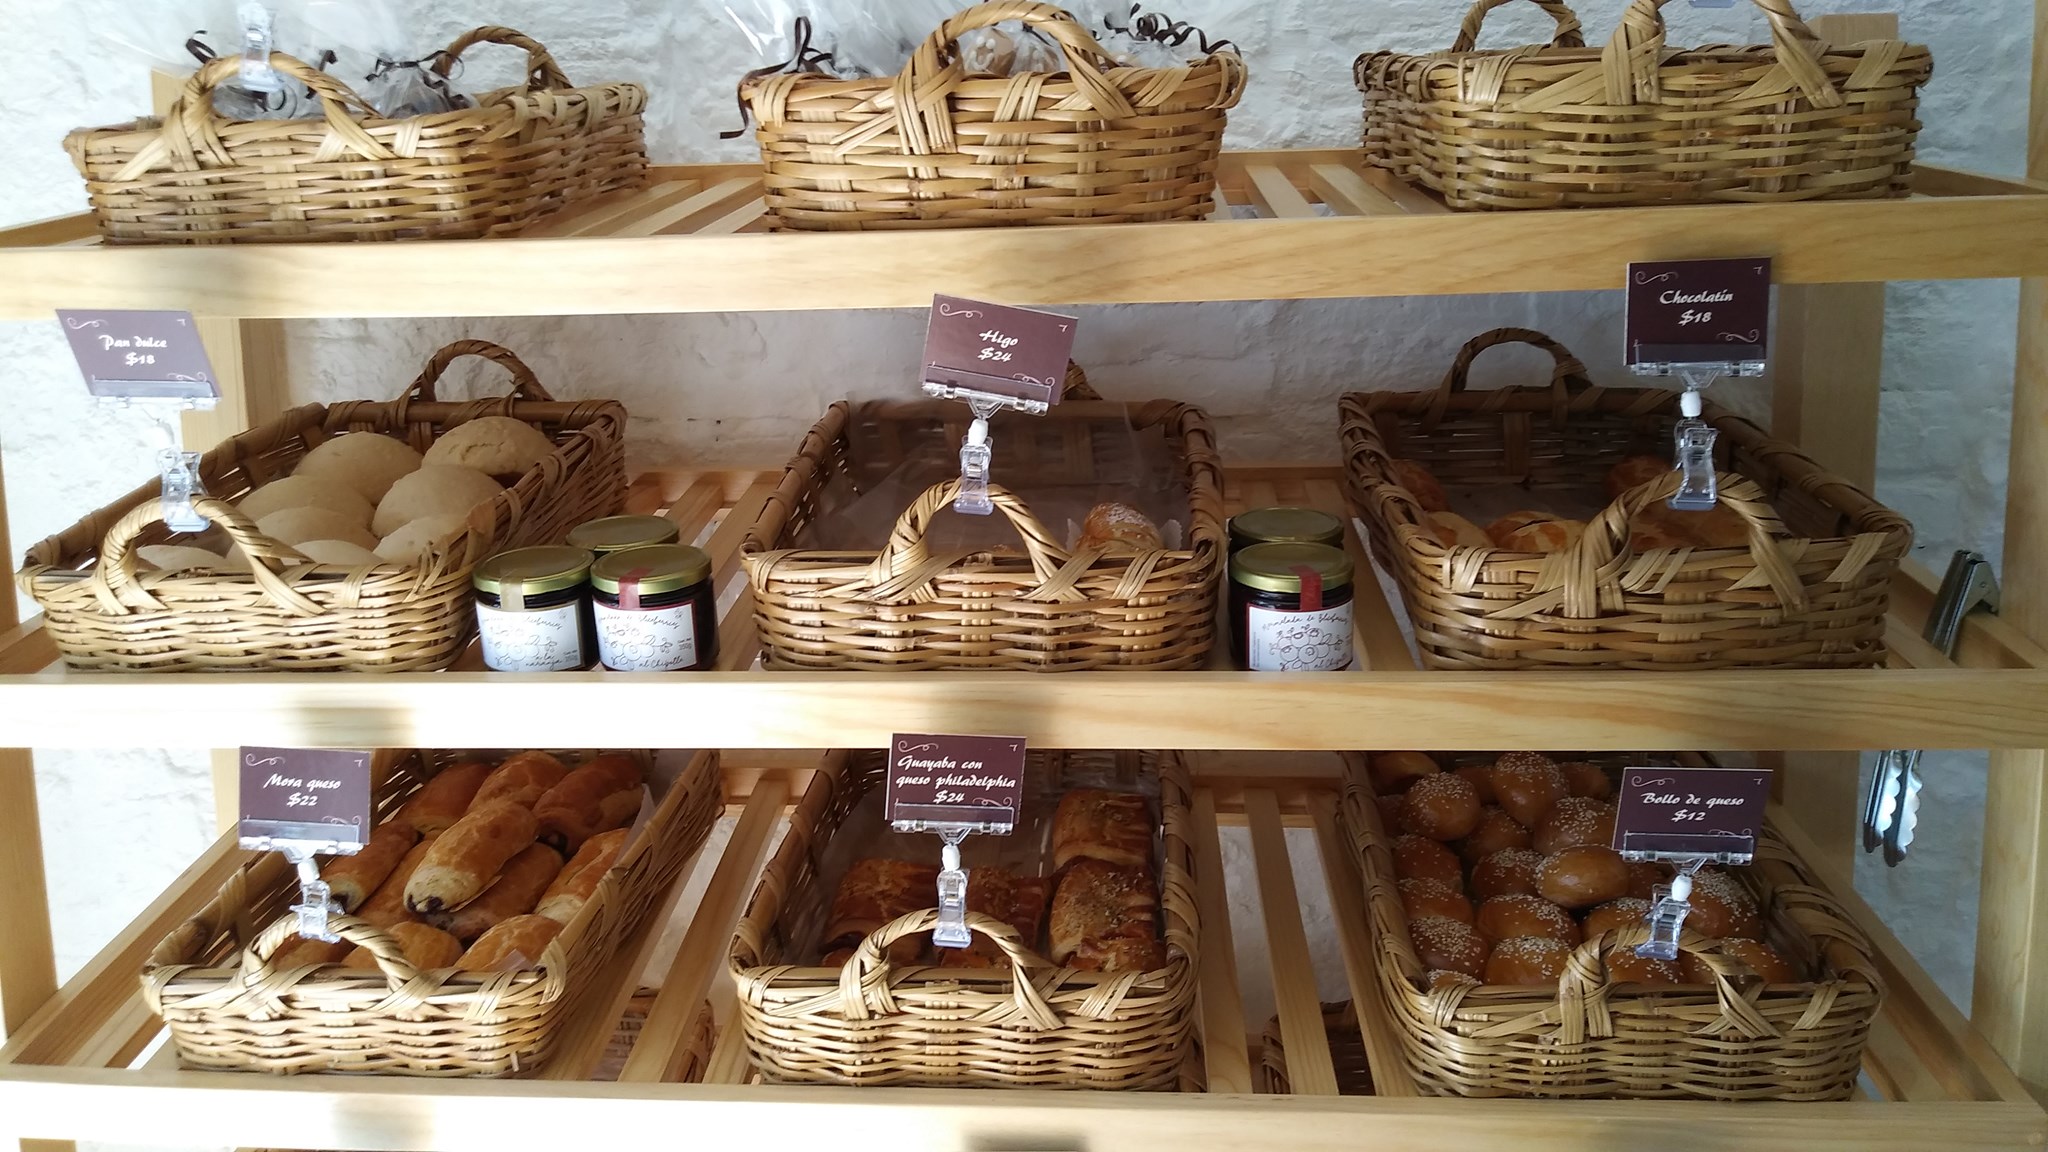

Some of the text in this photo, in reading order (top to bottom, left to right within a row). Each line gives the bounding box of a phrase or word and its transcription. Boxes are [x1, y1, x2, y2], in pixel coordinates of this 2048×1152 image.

[1659, 289, 1735, 305] Chocolatín
[1678, 309, 1712, 326] $18
[98, 334, 168, 351] Pan dulce
[978, 329, 1019, 348] Higo
[125, 352, 156, 366] $18
[977, 347, 1012, 363] $24
[897, 755, 983, 772] Guayaba con
[262, 773, 342, 792] Mora queso
[895, 773, 1016, 791] queso philadelphia
[286, 792, 319, 807] $22
[932, 789, 966, 804] $24
[1640, 792, 1745, 809] Bollo de queso
[1671, 808, 1706, 822] $12
